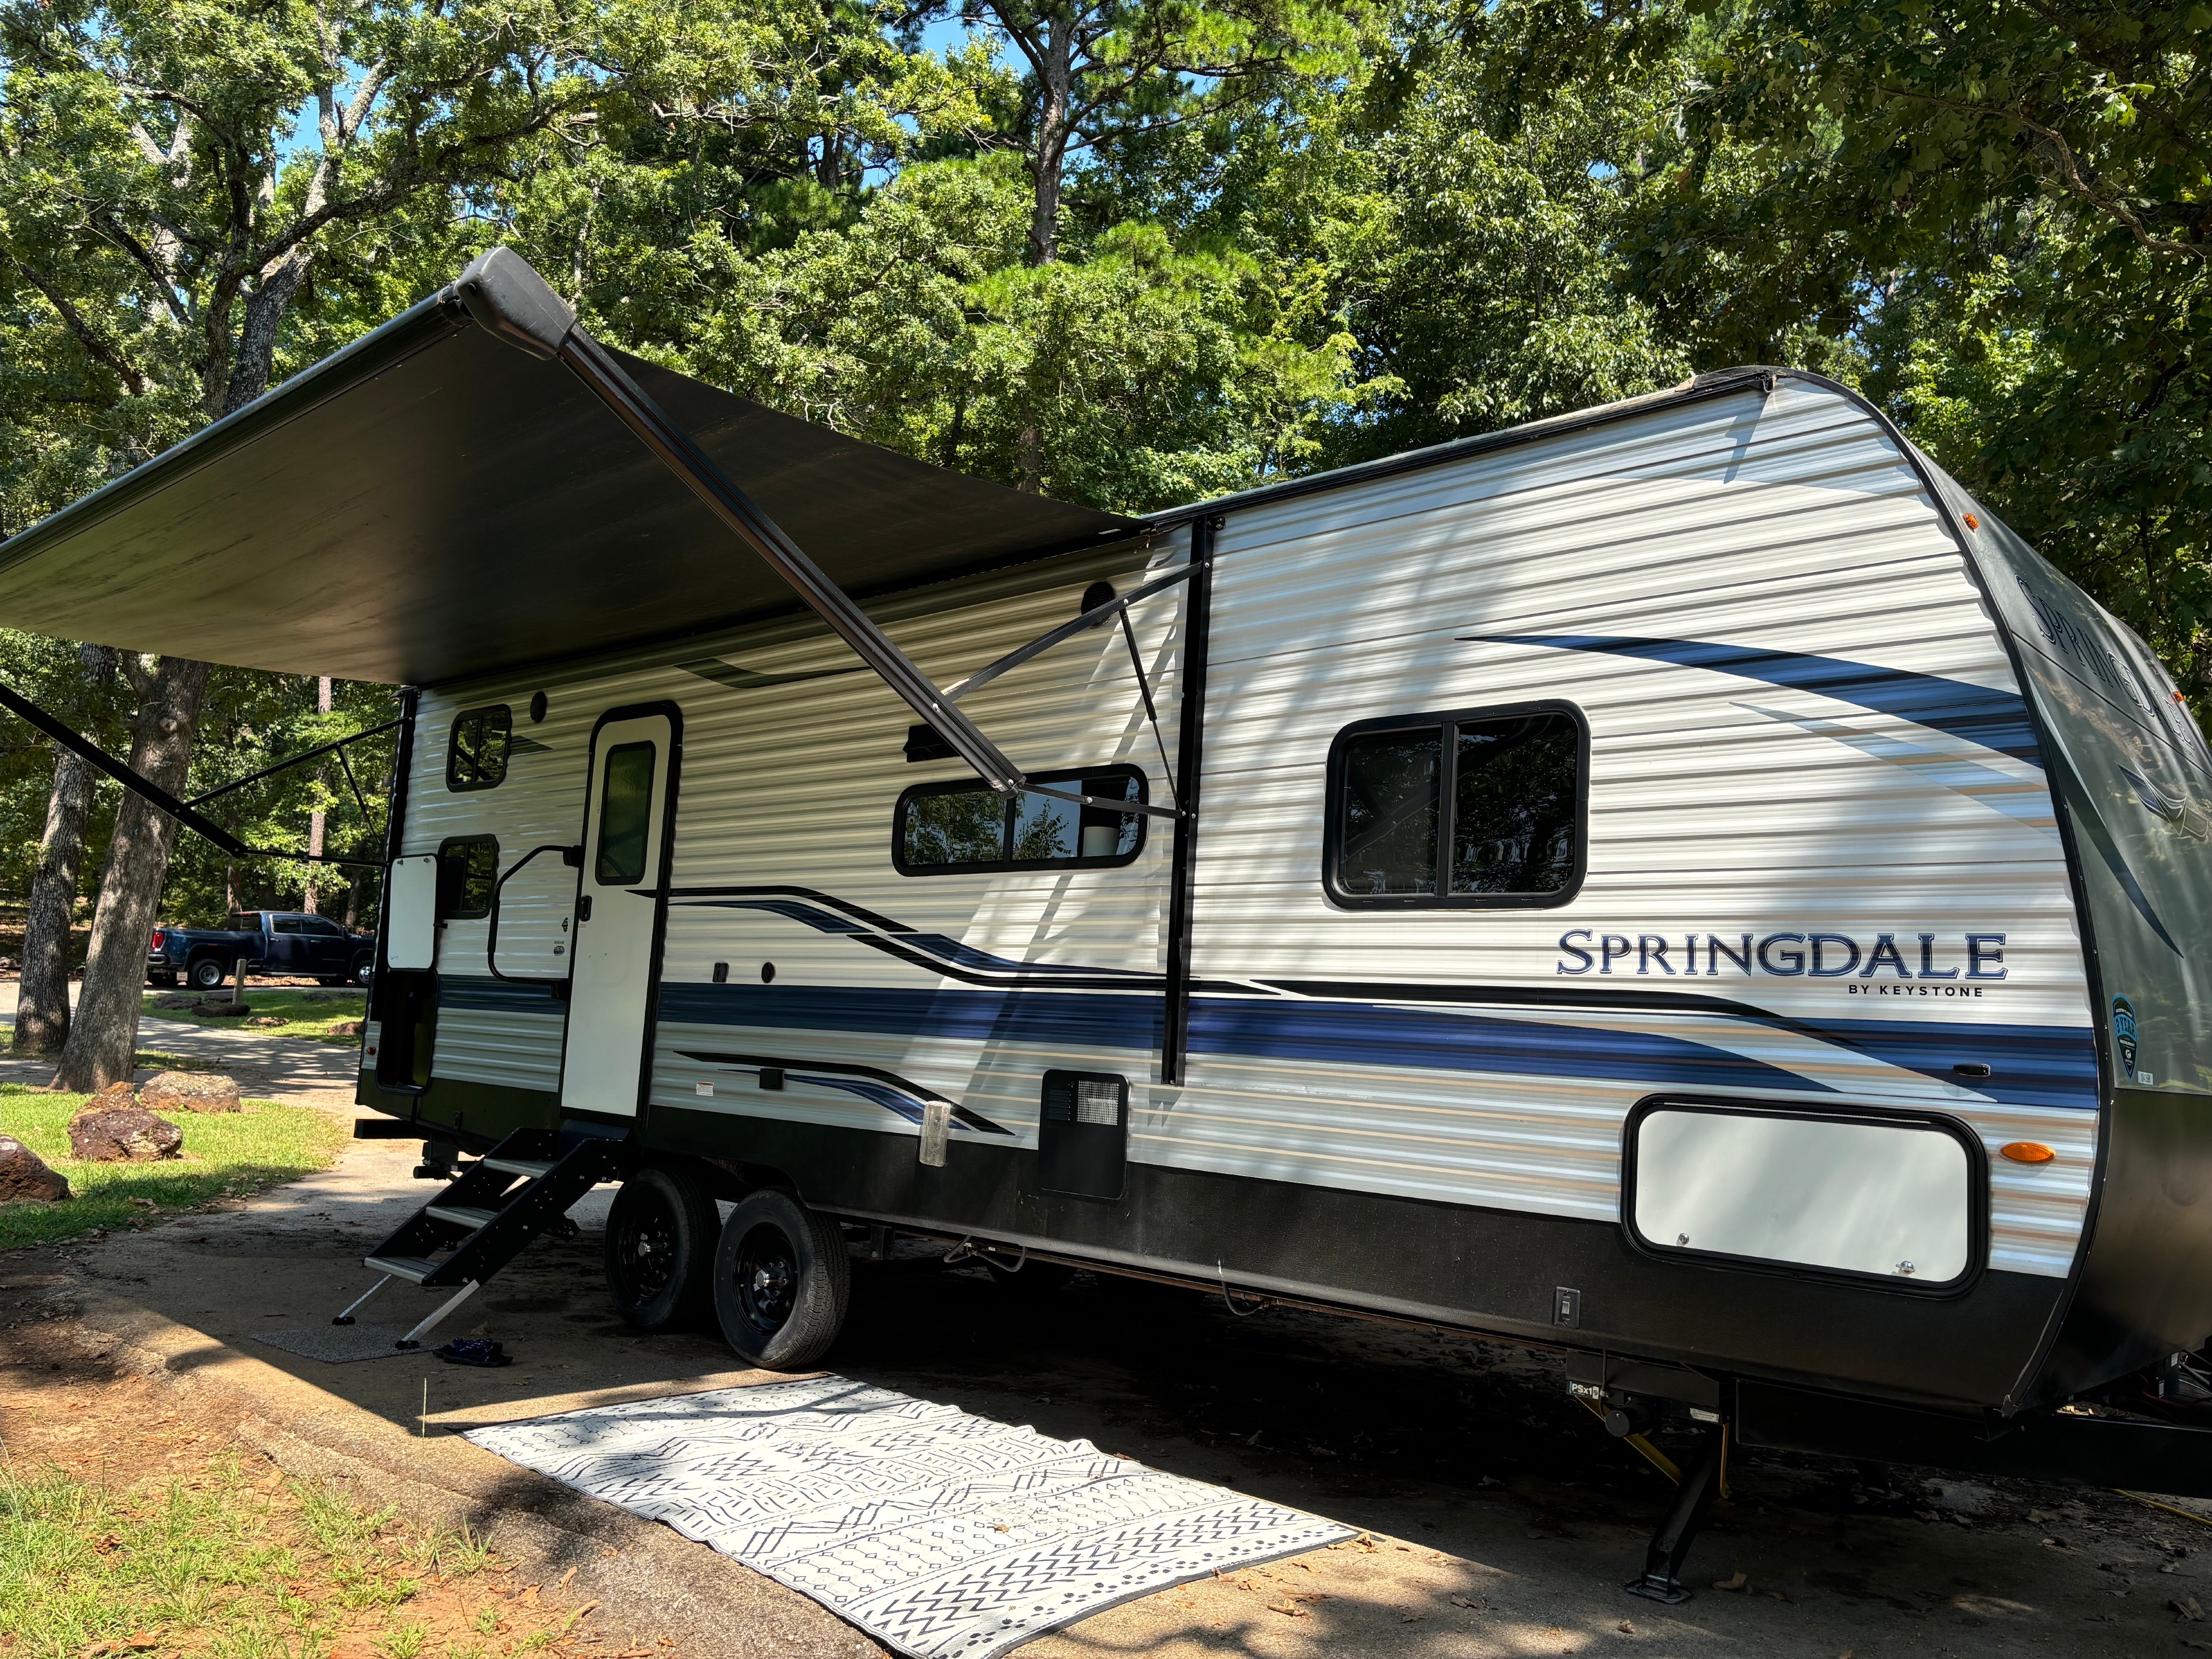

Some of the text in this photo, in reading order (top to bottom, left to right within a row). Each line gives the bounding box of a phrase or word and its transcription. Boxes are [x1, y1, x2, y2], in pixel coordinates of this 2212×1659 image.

[1557, 929, 2008, 980] SPRINGDALE
[1849, 985, 1982, 997] BY KEYSTONE
[2116, 1017, 2135, 1038] 3 YEAR
